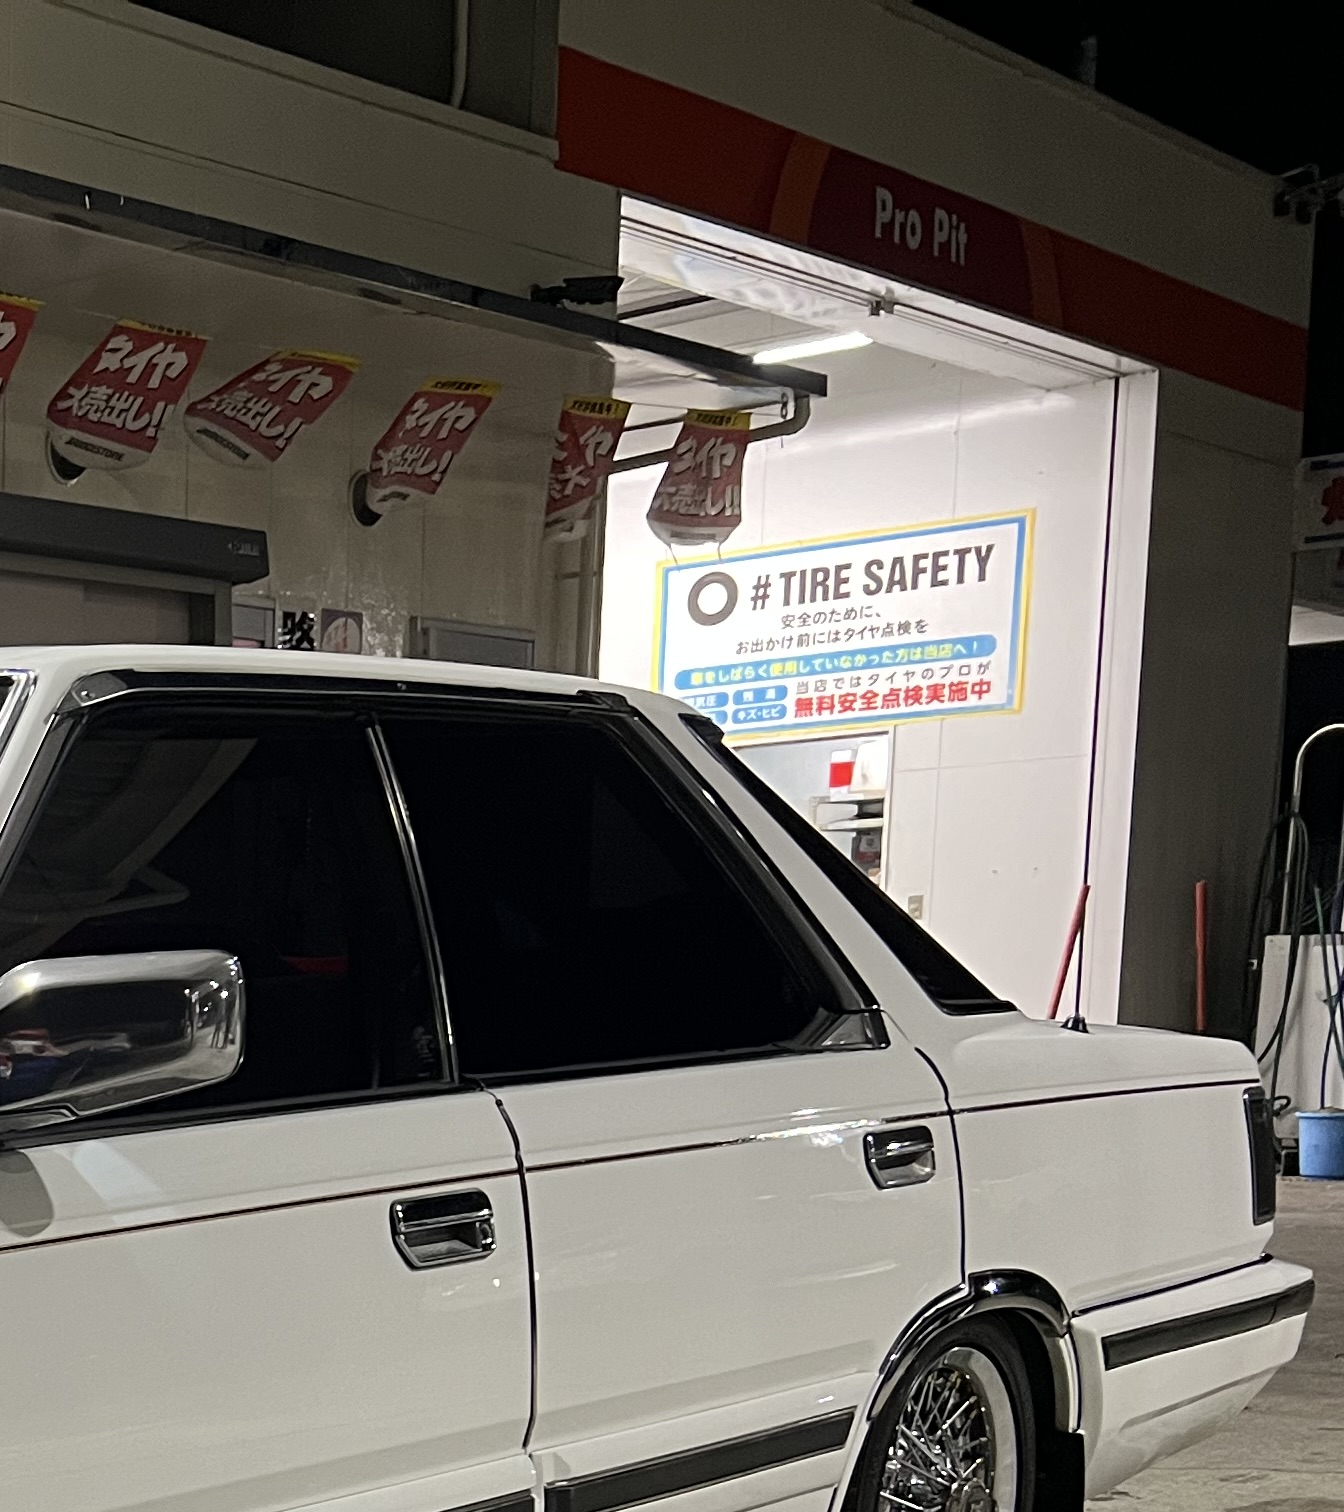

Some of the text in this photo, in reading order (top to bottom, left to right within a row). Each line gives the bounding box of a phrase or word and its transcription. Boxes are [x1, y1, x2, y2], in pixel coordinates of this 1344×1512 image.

[874, 185, 968, 267] Pro Pit
[92, 334, 189, 389] タイヤ
[779, 562, 853, 606] TIRE
[861, 543, 996, 597] SAFETY
[793, 678, 993, 720] 無料安全点検実施中
